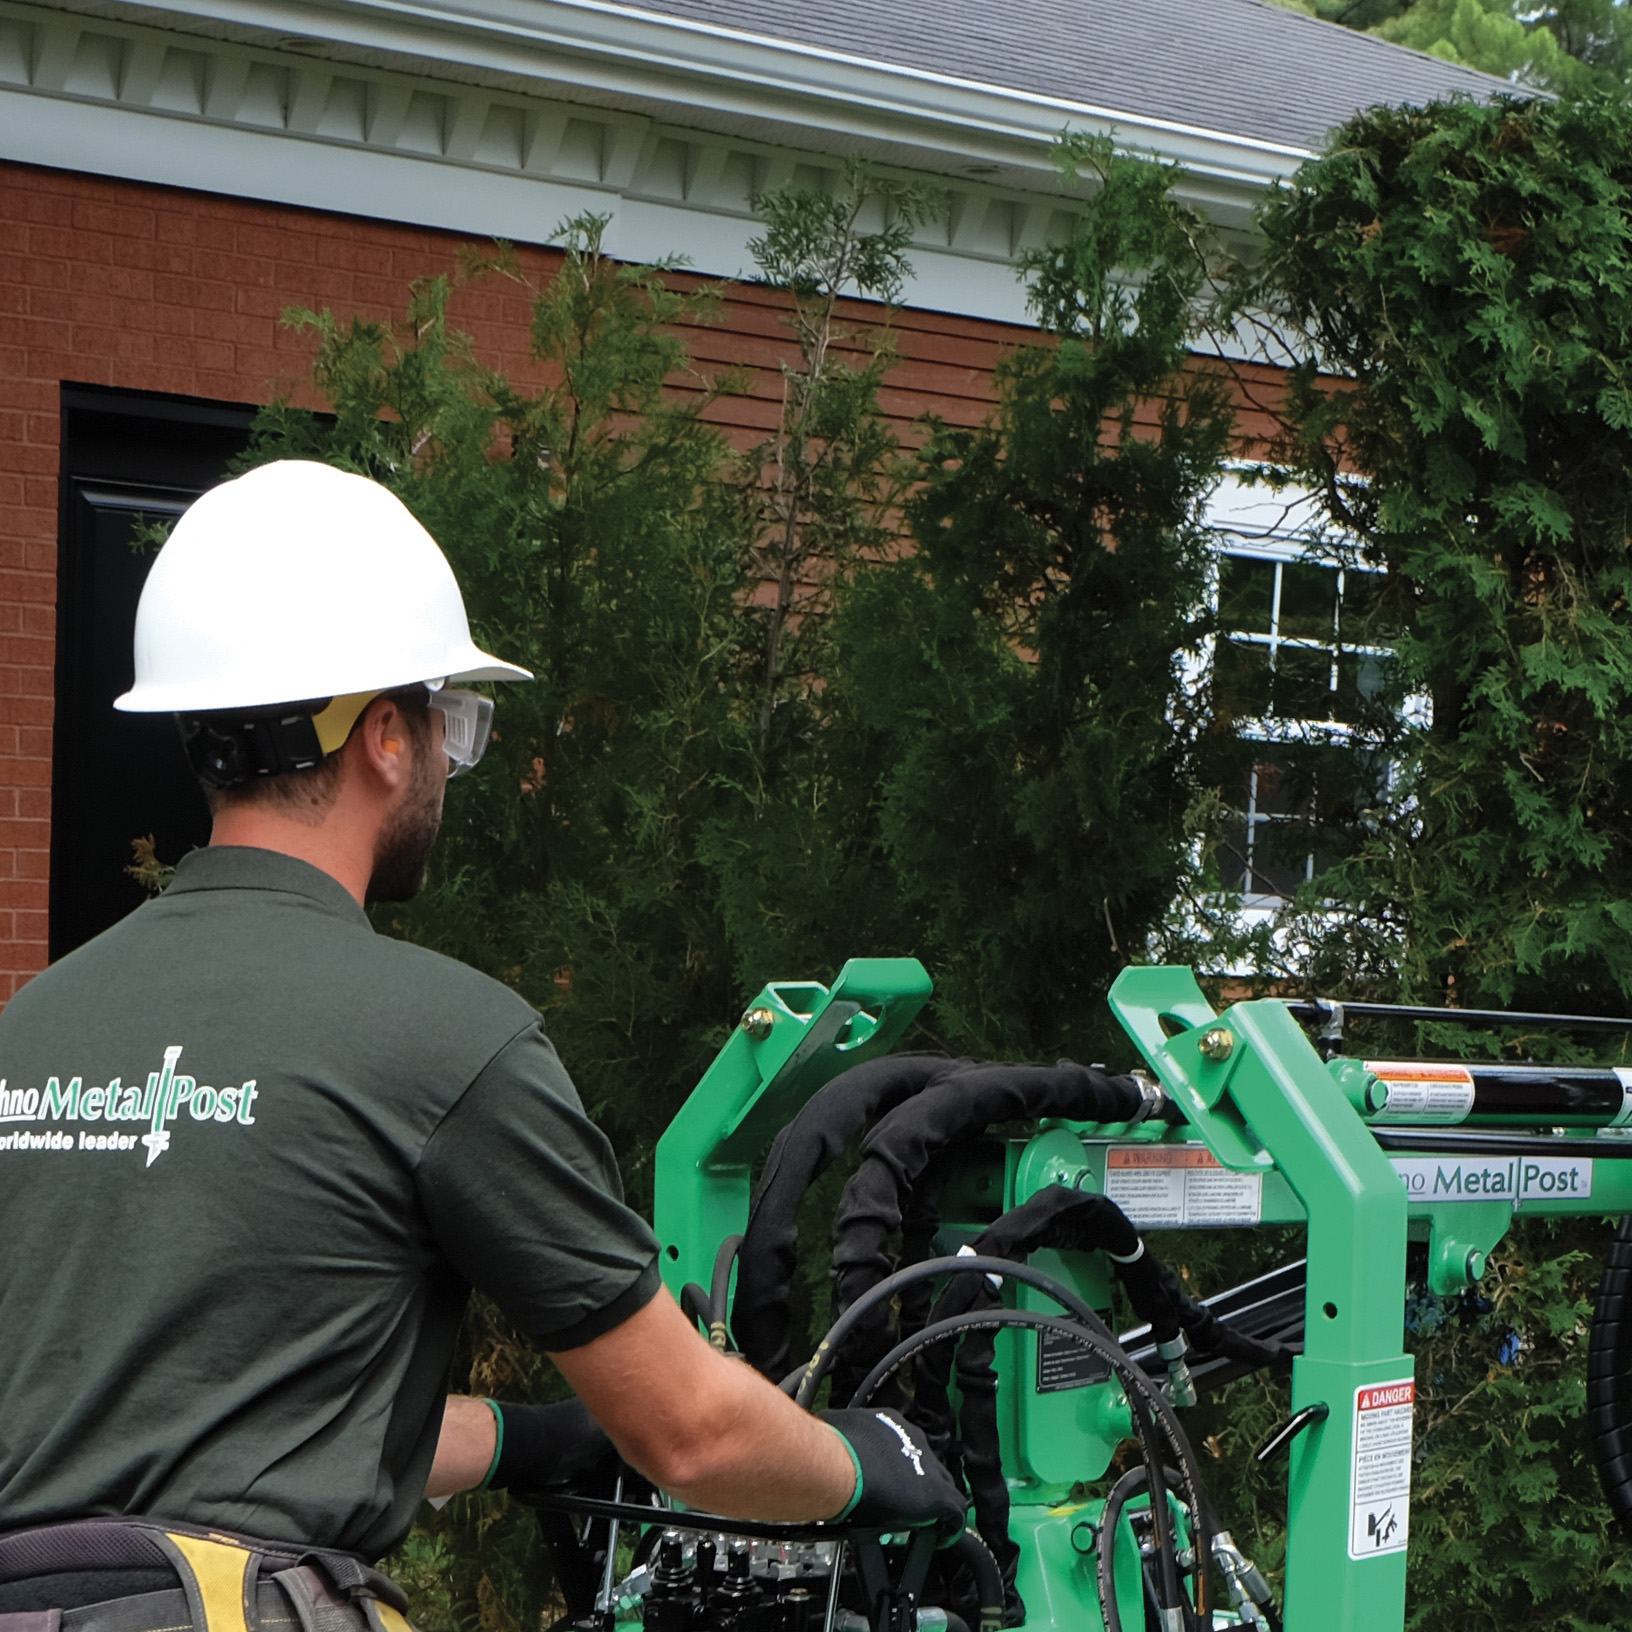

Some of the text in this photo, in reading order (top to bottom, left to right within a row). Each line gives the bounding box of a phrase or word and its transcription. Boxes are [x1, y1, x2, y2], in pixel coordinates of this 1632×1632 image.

[78, 1130, 140, 1152] leader
[1133, 1152, 1173, 1164] WARNING
[1372, 1386, 1412, 1406] DANGER
